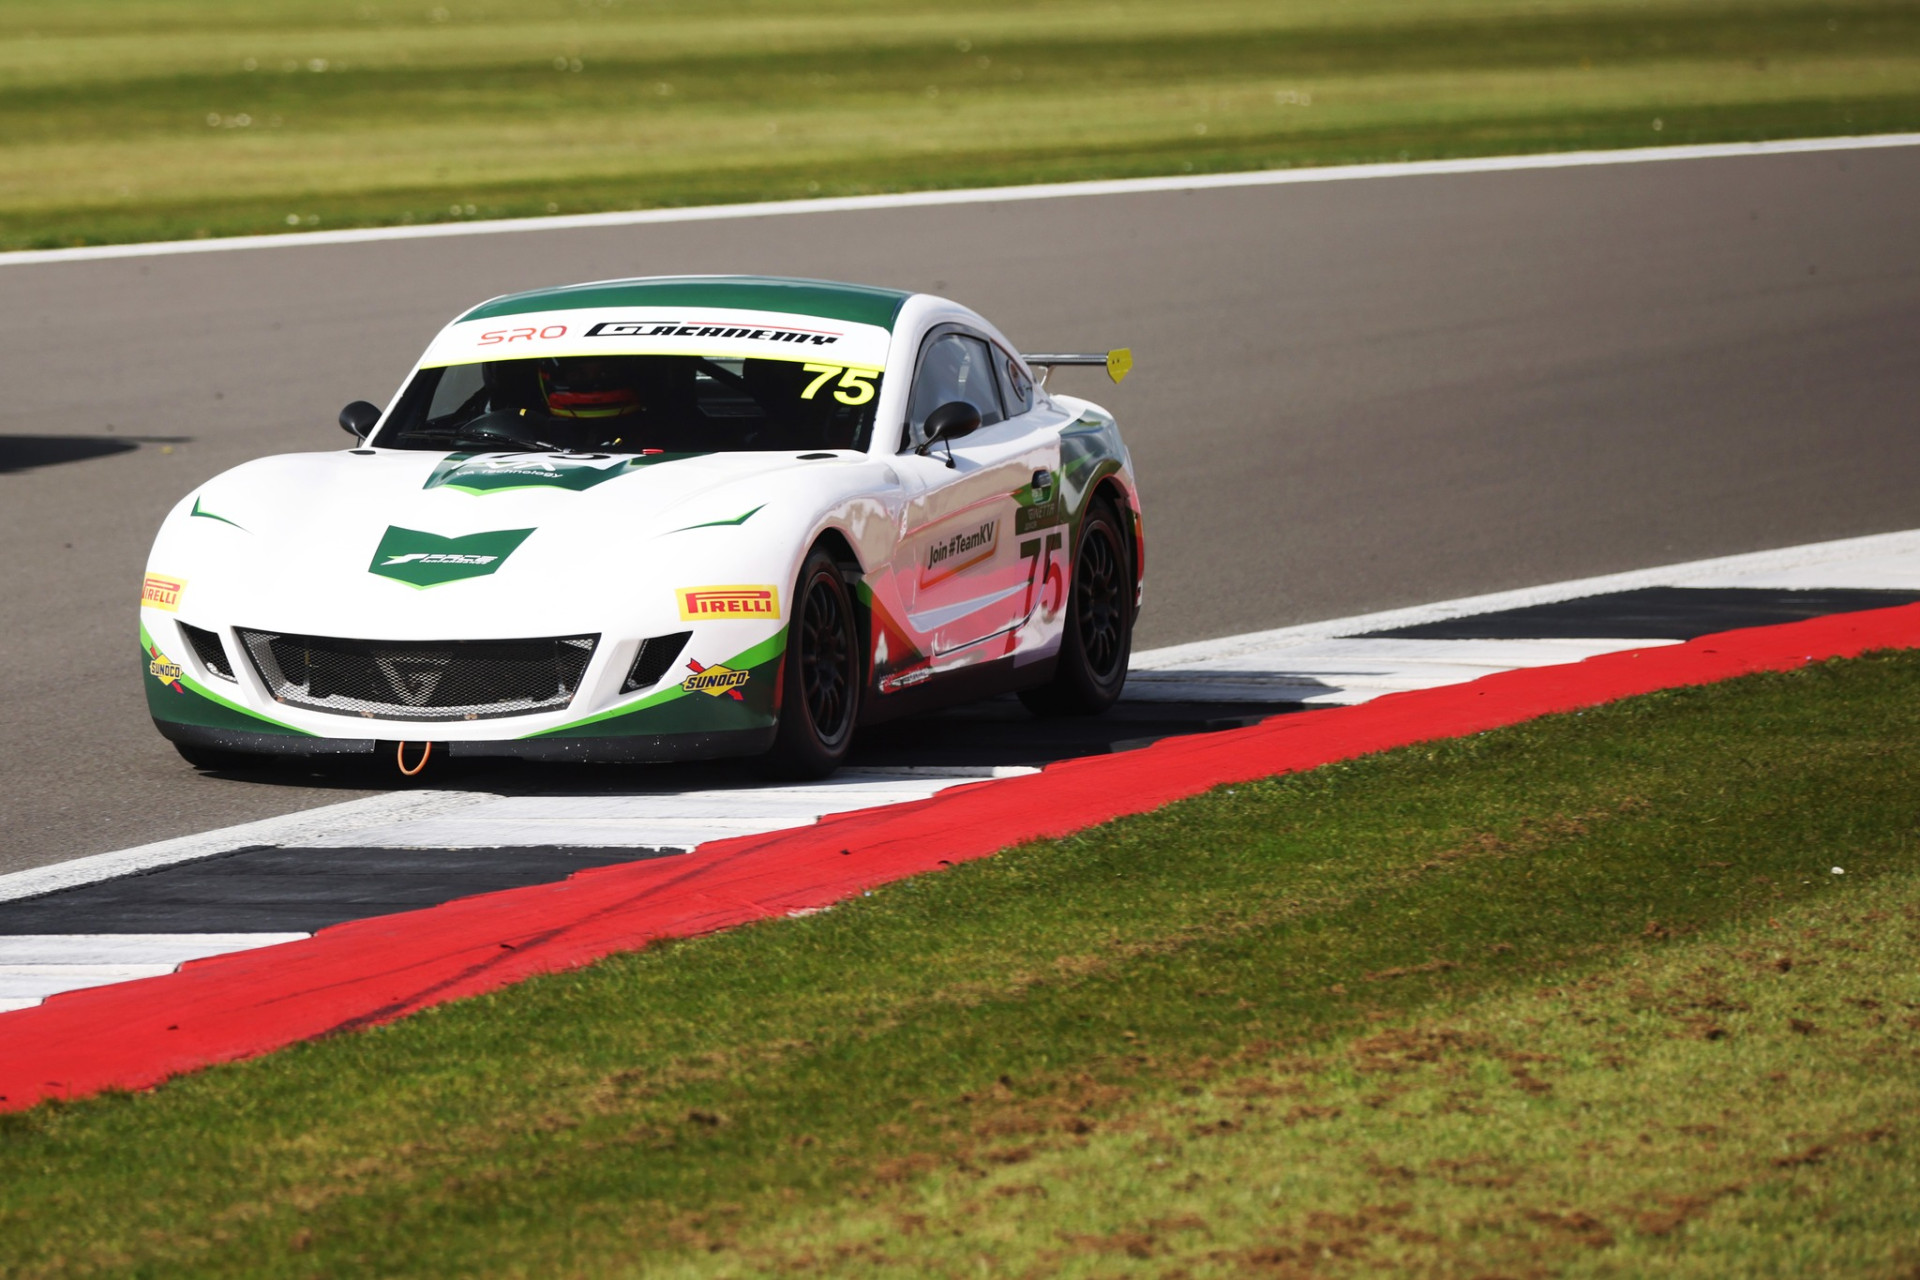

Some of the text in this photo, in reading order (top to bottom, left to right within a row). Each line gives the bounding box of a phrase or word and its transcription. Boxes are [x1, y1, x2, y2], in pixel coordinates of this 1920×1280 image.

[477, 325, 567, 346] SRO
[800, 362, 880, 406] 75
[927, 520, 994, 571] Join #TeamKV
[141, 578, 181, 605] PIRELLI
[1020, 532, 1063, 626] 75
[685, 590, 772, 614] PIRELLI
[151, 662, 180, 678] SUNOCO
[685, 671, 748, 690] SUNOCO
